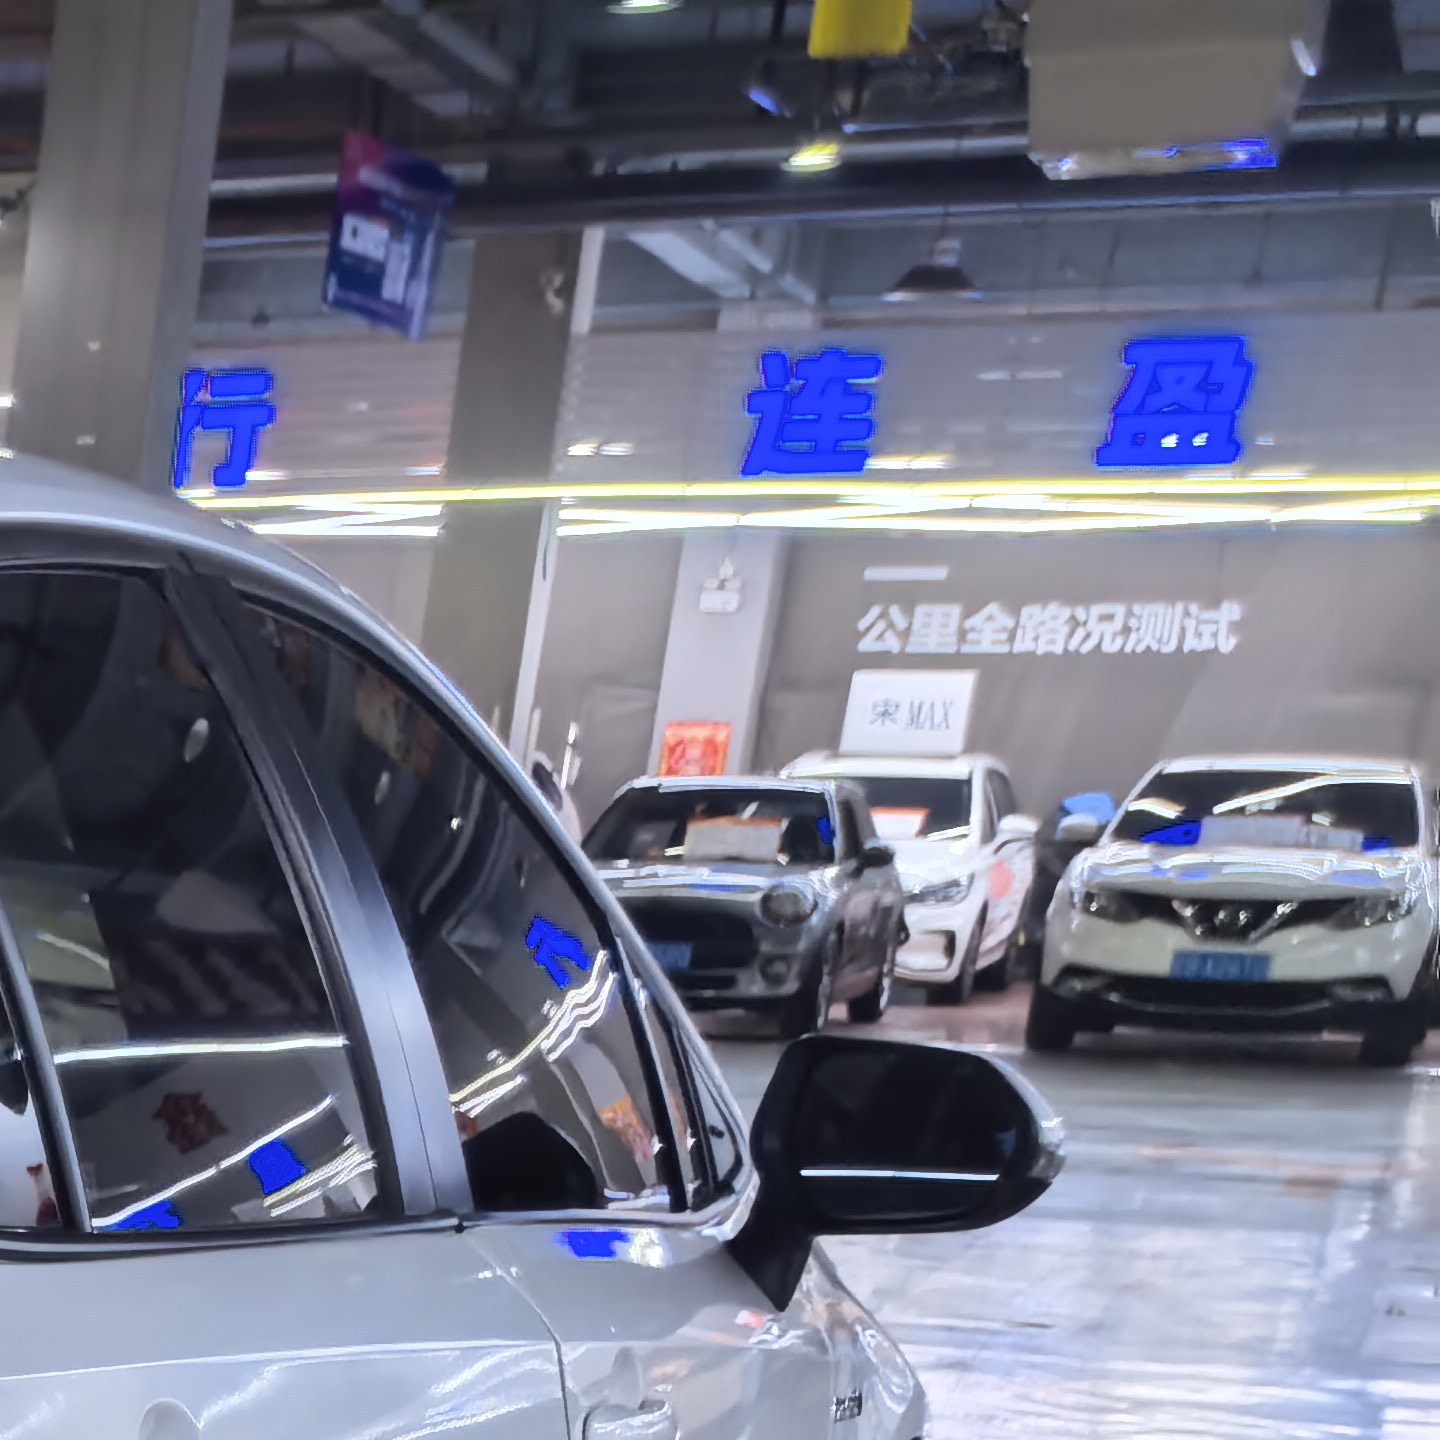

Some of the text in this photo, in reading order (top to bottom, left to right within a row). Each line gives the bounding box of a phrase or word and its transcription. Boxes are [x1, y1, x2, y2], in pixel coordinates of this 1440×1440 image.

[174, 367, 277, 488] 行
[856, 600, 1243, 656] 公里全路况测试
[904, 699, 955, 731] MAX
